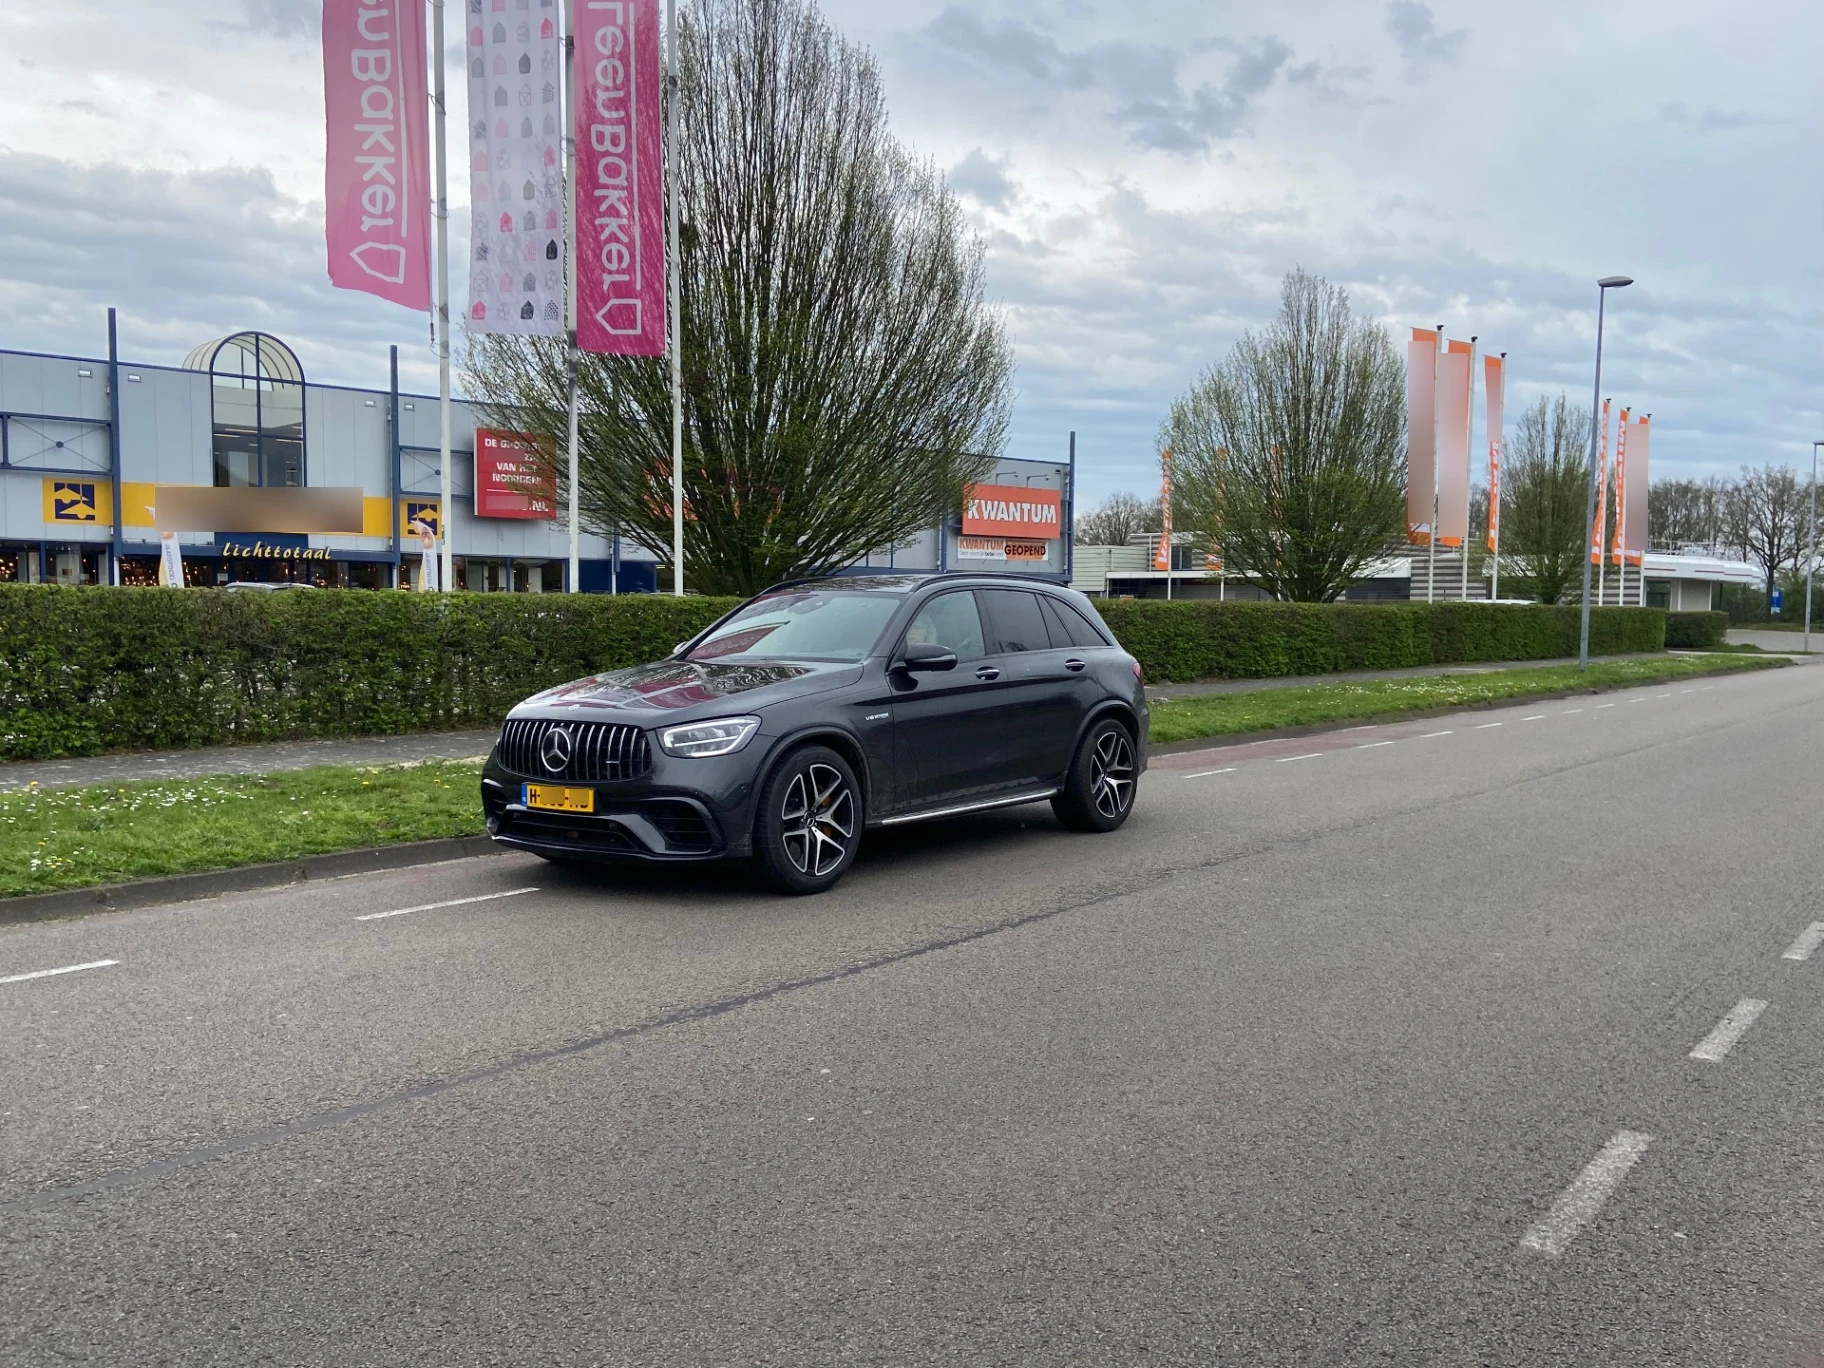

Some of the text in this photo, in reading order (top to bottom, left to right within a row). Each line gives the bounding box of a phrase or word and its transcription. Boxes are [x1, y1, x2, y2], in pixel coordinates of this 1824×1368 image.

[484, 438, 498, 448] DE
[496, 462, 516, 471] VAN
[967, 499, 1056, 524] KWANTUM
[1004, 544, 1046, 556] GEOPEND
